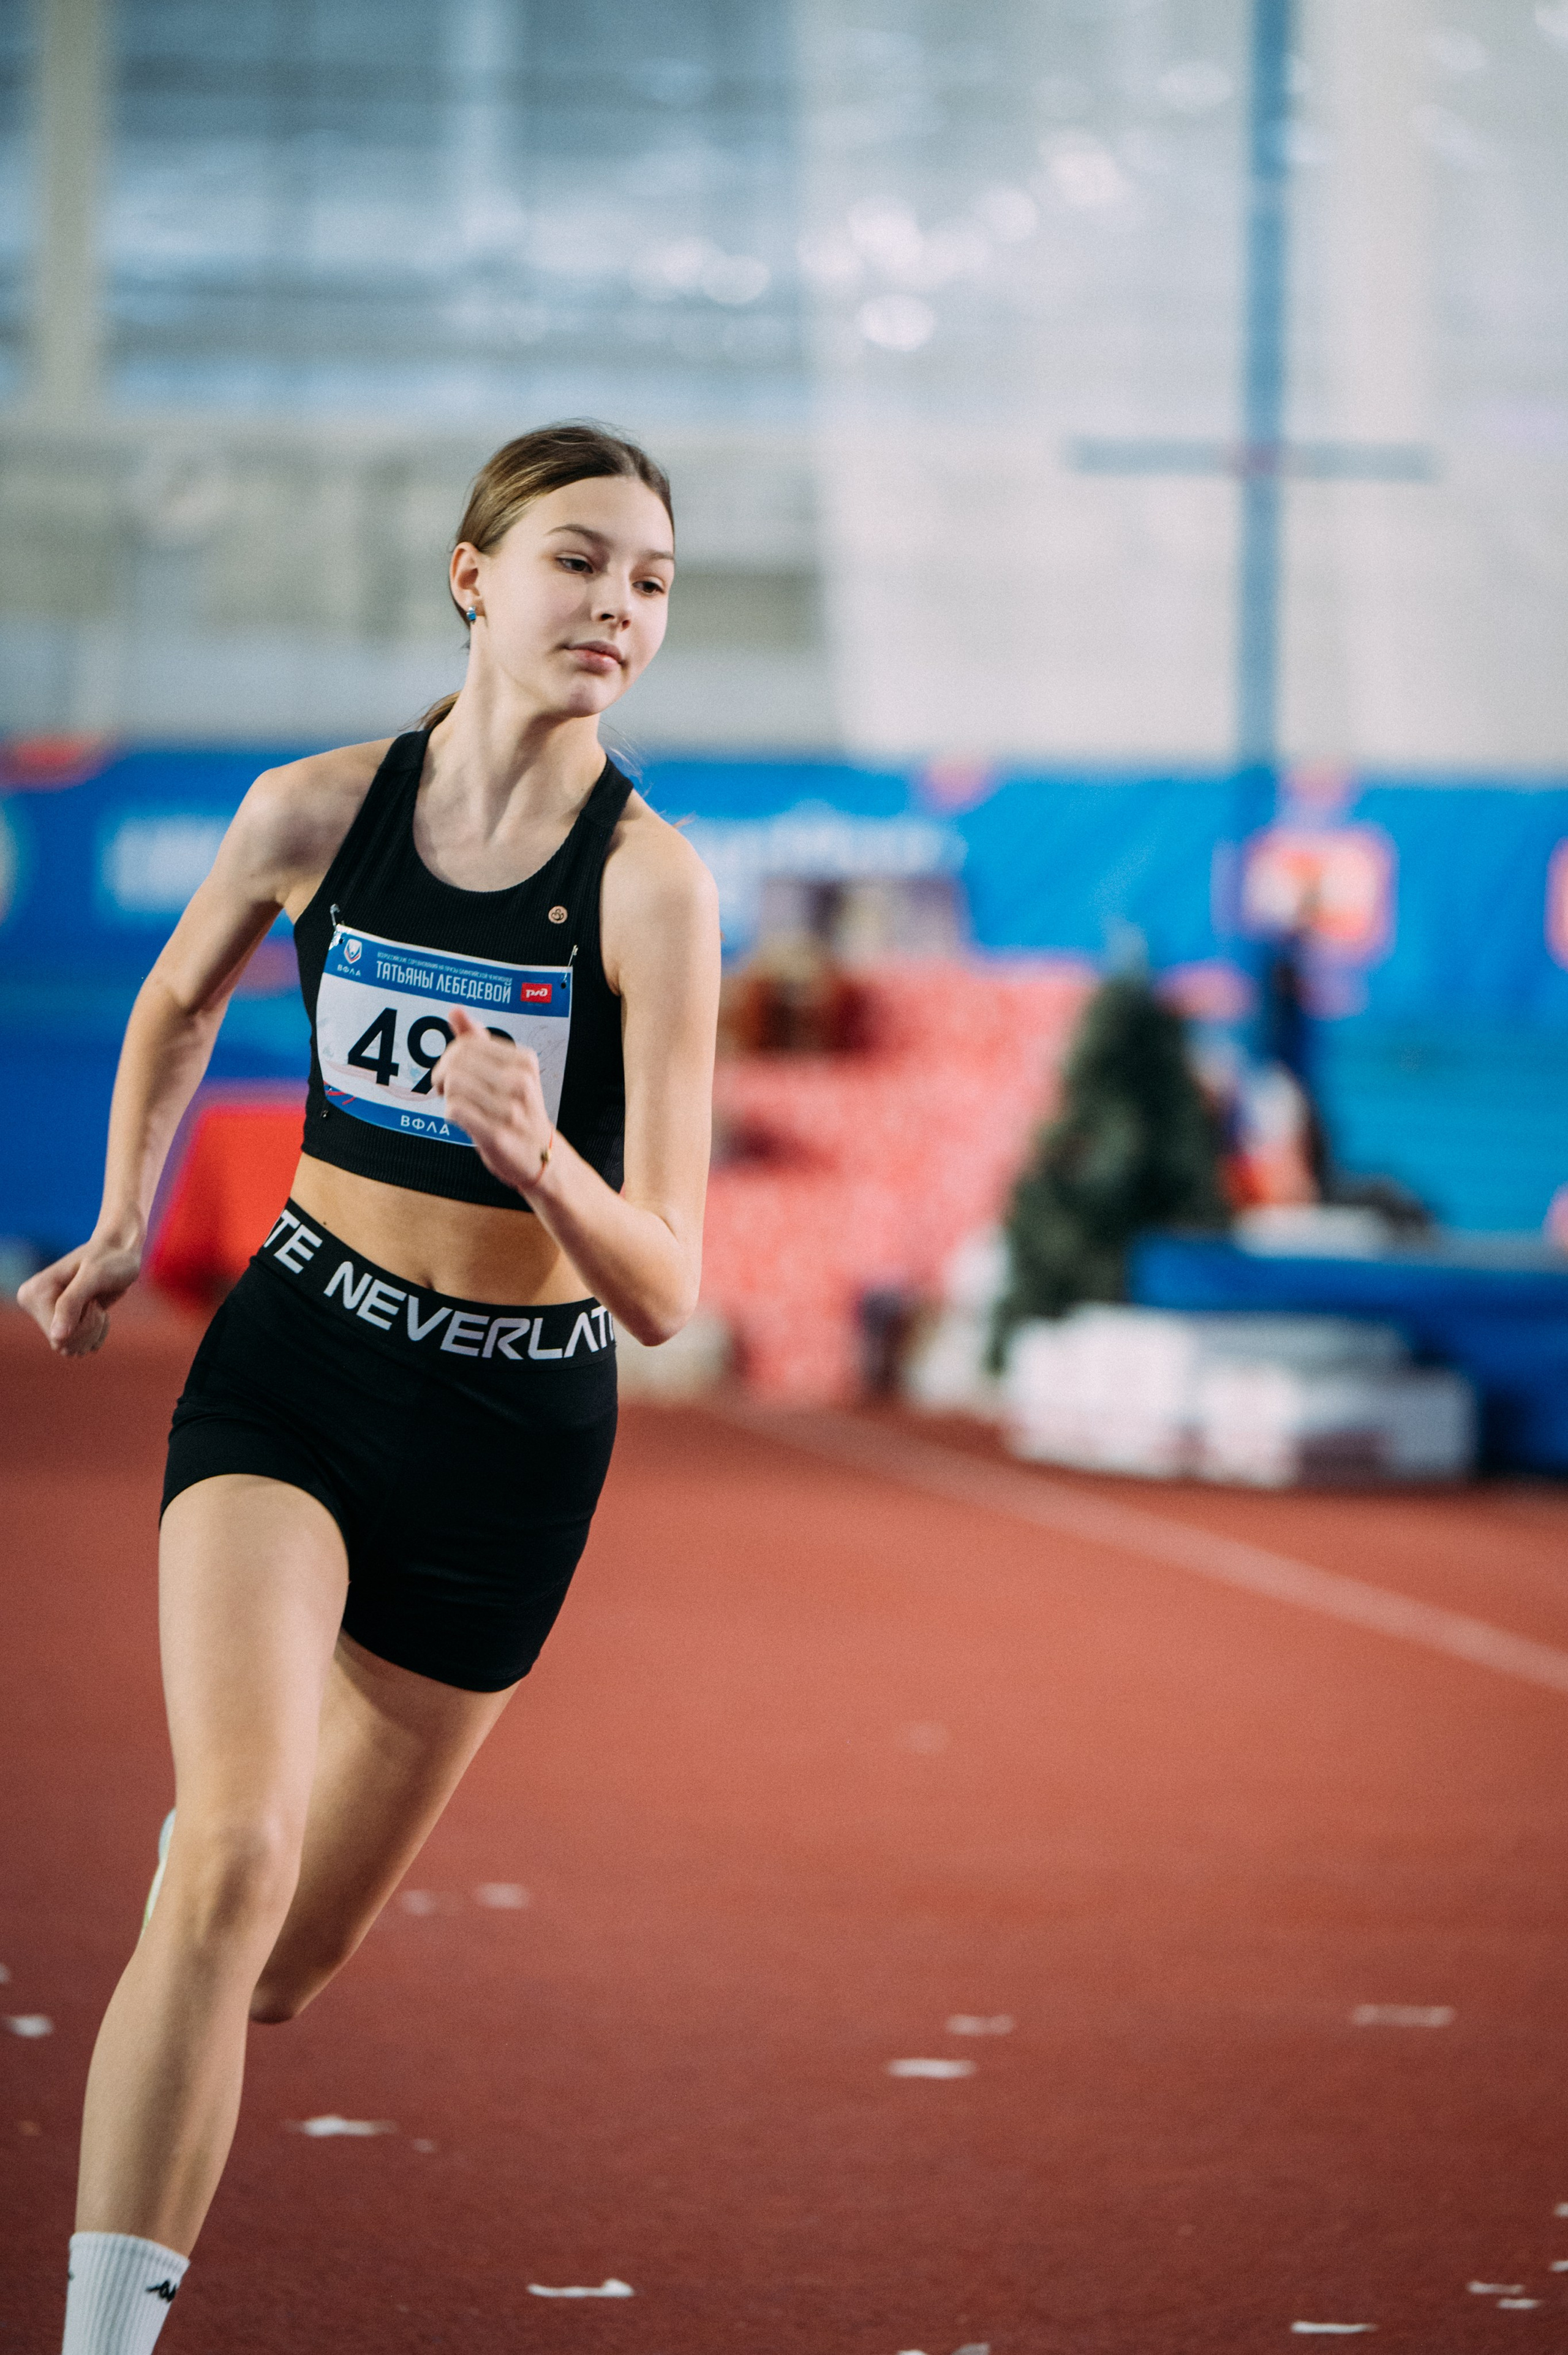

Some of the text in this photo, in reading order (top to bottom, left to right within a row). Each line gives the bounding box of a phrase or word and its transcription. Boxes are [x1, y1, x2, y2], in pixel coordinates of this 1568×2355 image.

[337, 964, 361, 977] ВФЛА
[376, 960, 512, 1004] ТАТЬЯНЫ ЛЕБЕДЕВОЙ
[347, 1007, 516, 1095] 49
[400, 1114, 450, 1136] ВФЛА
[323, 1261, 614, 1360] NEVERLAT
